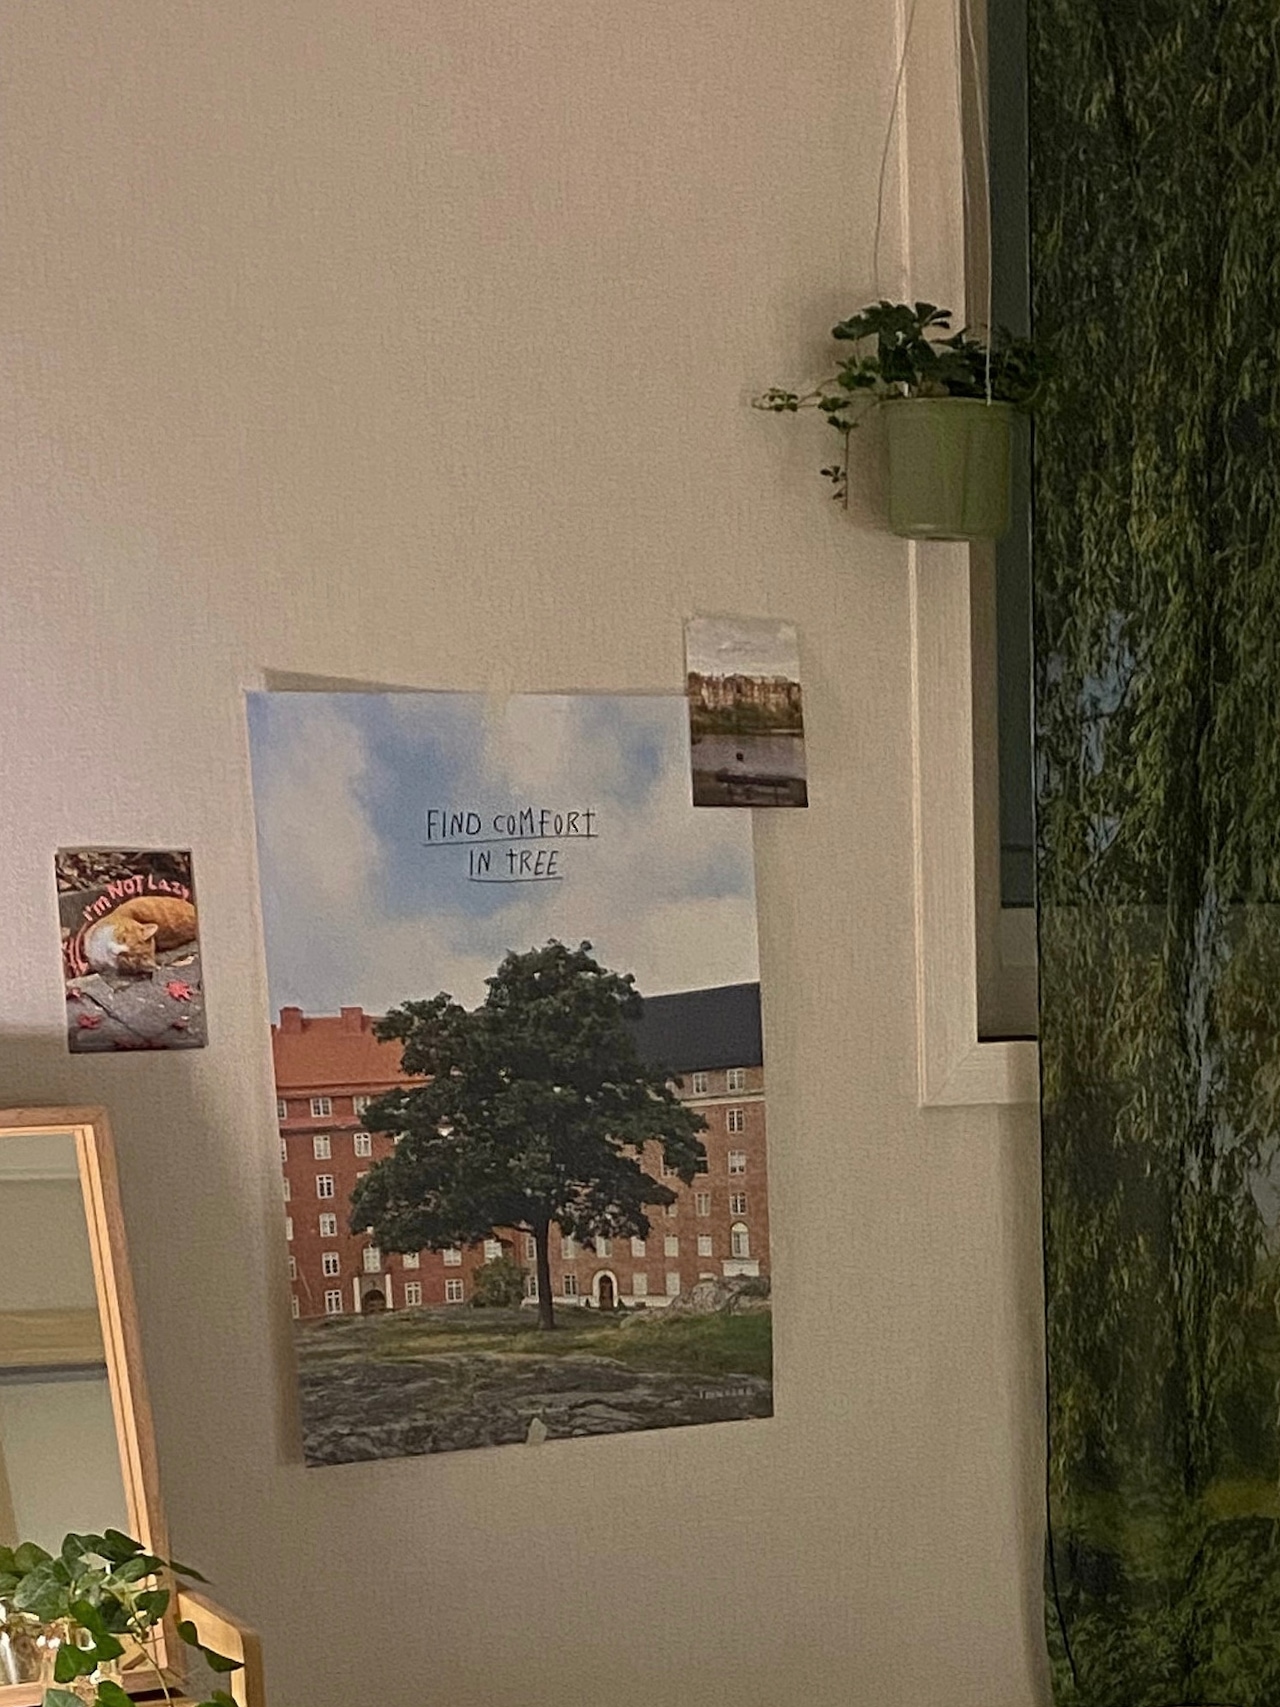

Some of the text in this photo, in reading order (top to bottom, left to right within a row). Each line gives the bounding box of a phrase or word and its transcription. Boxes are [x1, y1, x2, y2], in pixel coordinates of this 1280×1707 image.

[427, 806, 597, 840] FIND COMFORT
[469, 847, 559, 876] IN TREE
[105, 874, 145, 900] NOT
